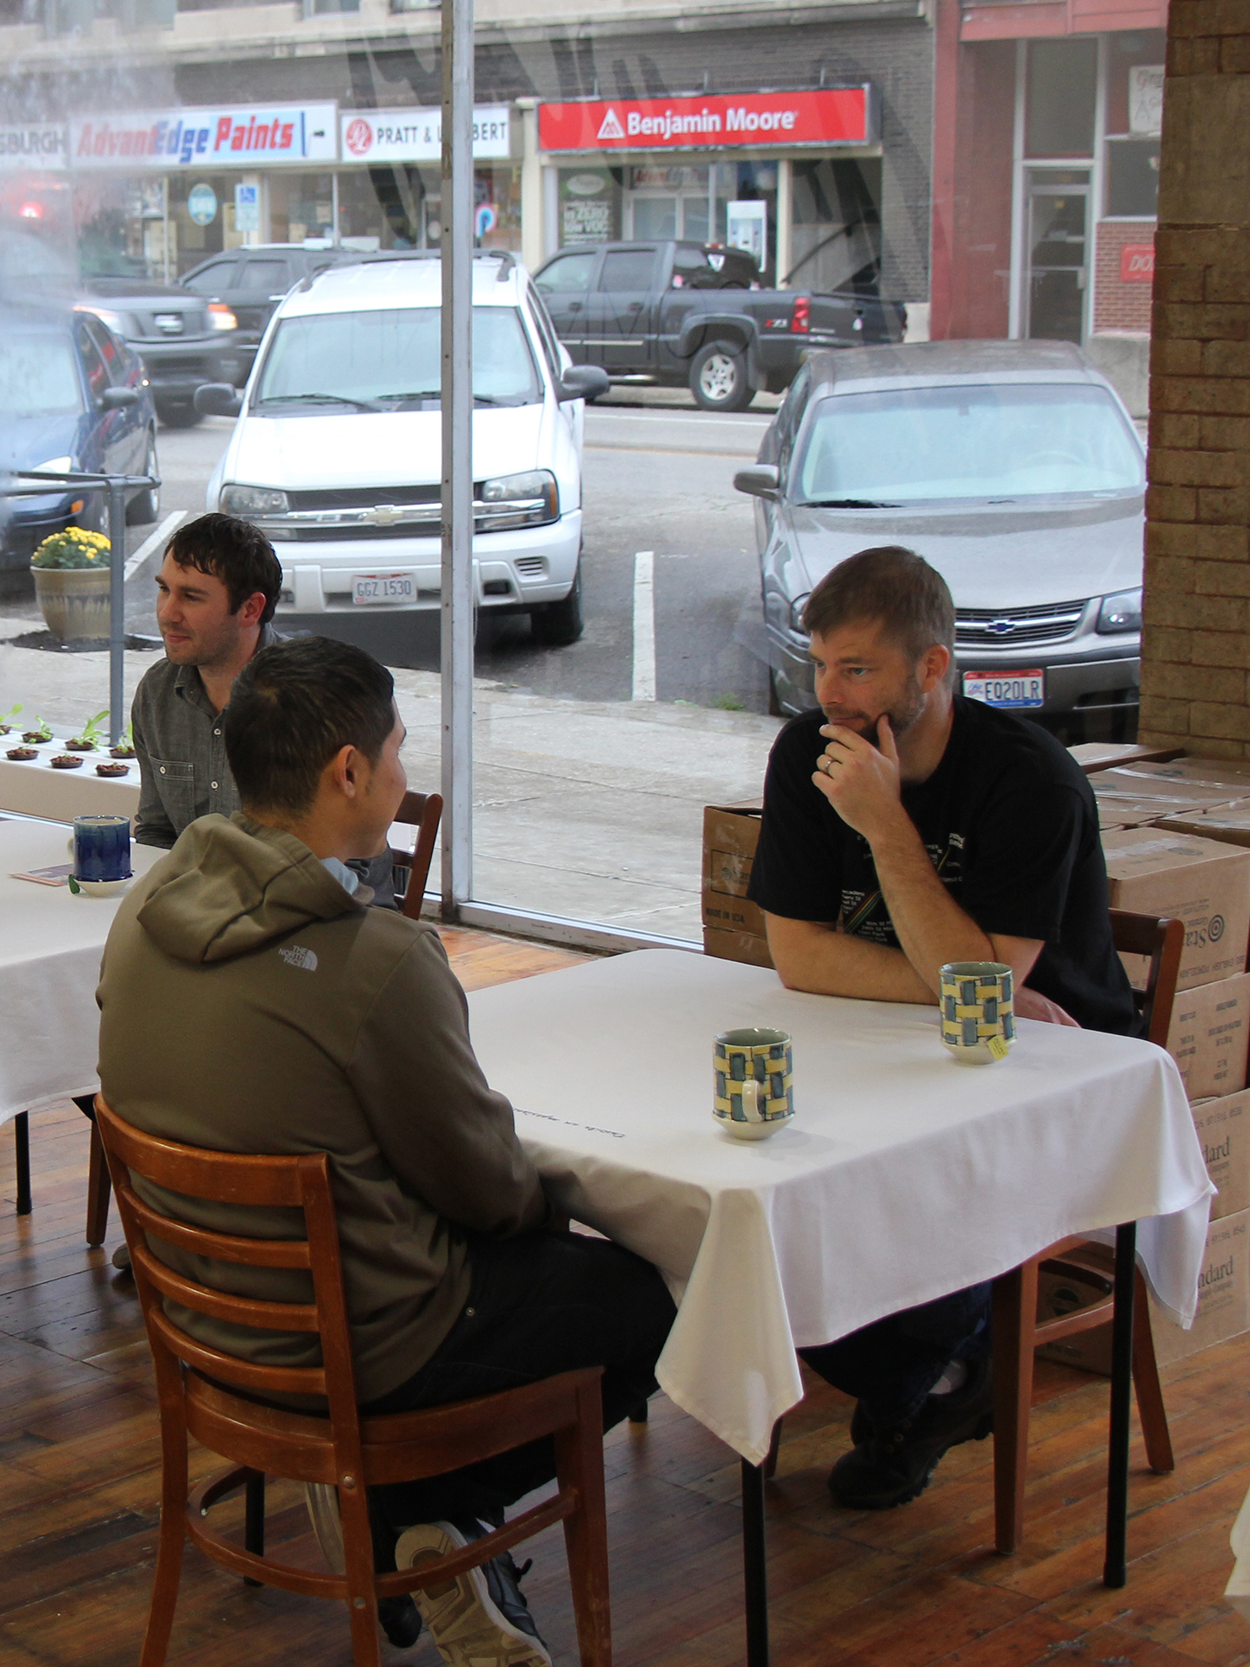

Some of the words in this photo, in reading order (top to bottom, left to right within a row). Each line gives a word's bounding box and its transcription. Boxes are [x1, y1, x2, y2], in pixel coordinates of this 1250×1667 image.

[214, 114, 294, 151] Paints
[377, 126, 418, 144] PRATT
[424, 126, 431, 142] &
[437, 122, 507, 142] LBERT
[627, 107, 722, 140] Benjamin
[725, 107, 796, 131] Moore
[1128, 255, 1154, 271] DO
[357, 581, 379, 596] GGZ
[384, 580, 411, 595] 1530
[1184, 929, 1207, 948] Sta
[1198, 1255, 1233, 1289] ndard
